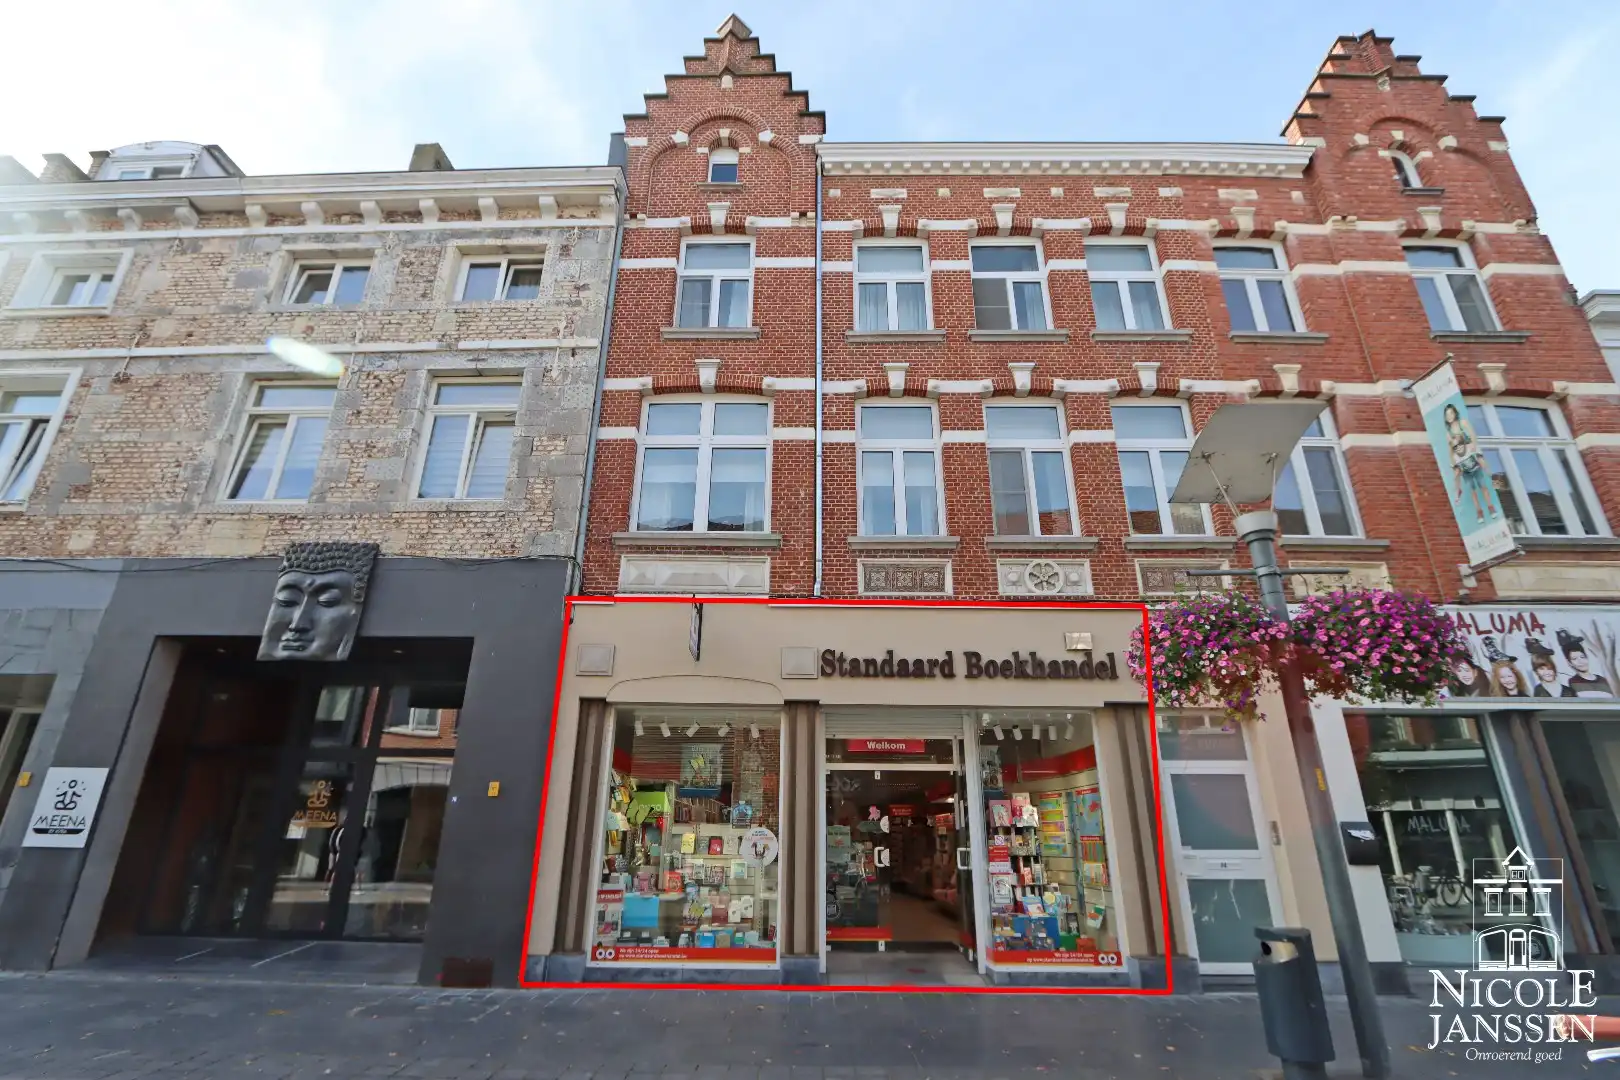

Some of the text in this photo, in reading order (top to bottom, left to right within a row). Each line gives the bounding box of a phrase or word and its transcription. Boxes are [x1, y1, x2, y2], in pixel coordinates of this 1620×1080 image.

[1443, 611, 1545, 636] ALUMA
[820, 649, 1119, 681] Standaard Boekhandel
[866, 741, 906, 750] Welkom
[33, 815, 86, 827] MEENA
[291, 810, 337, 821] MEENA
